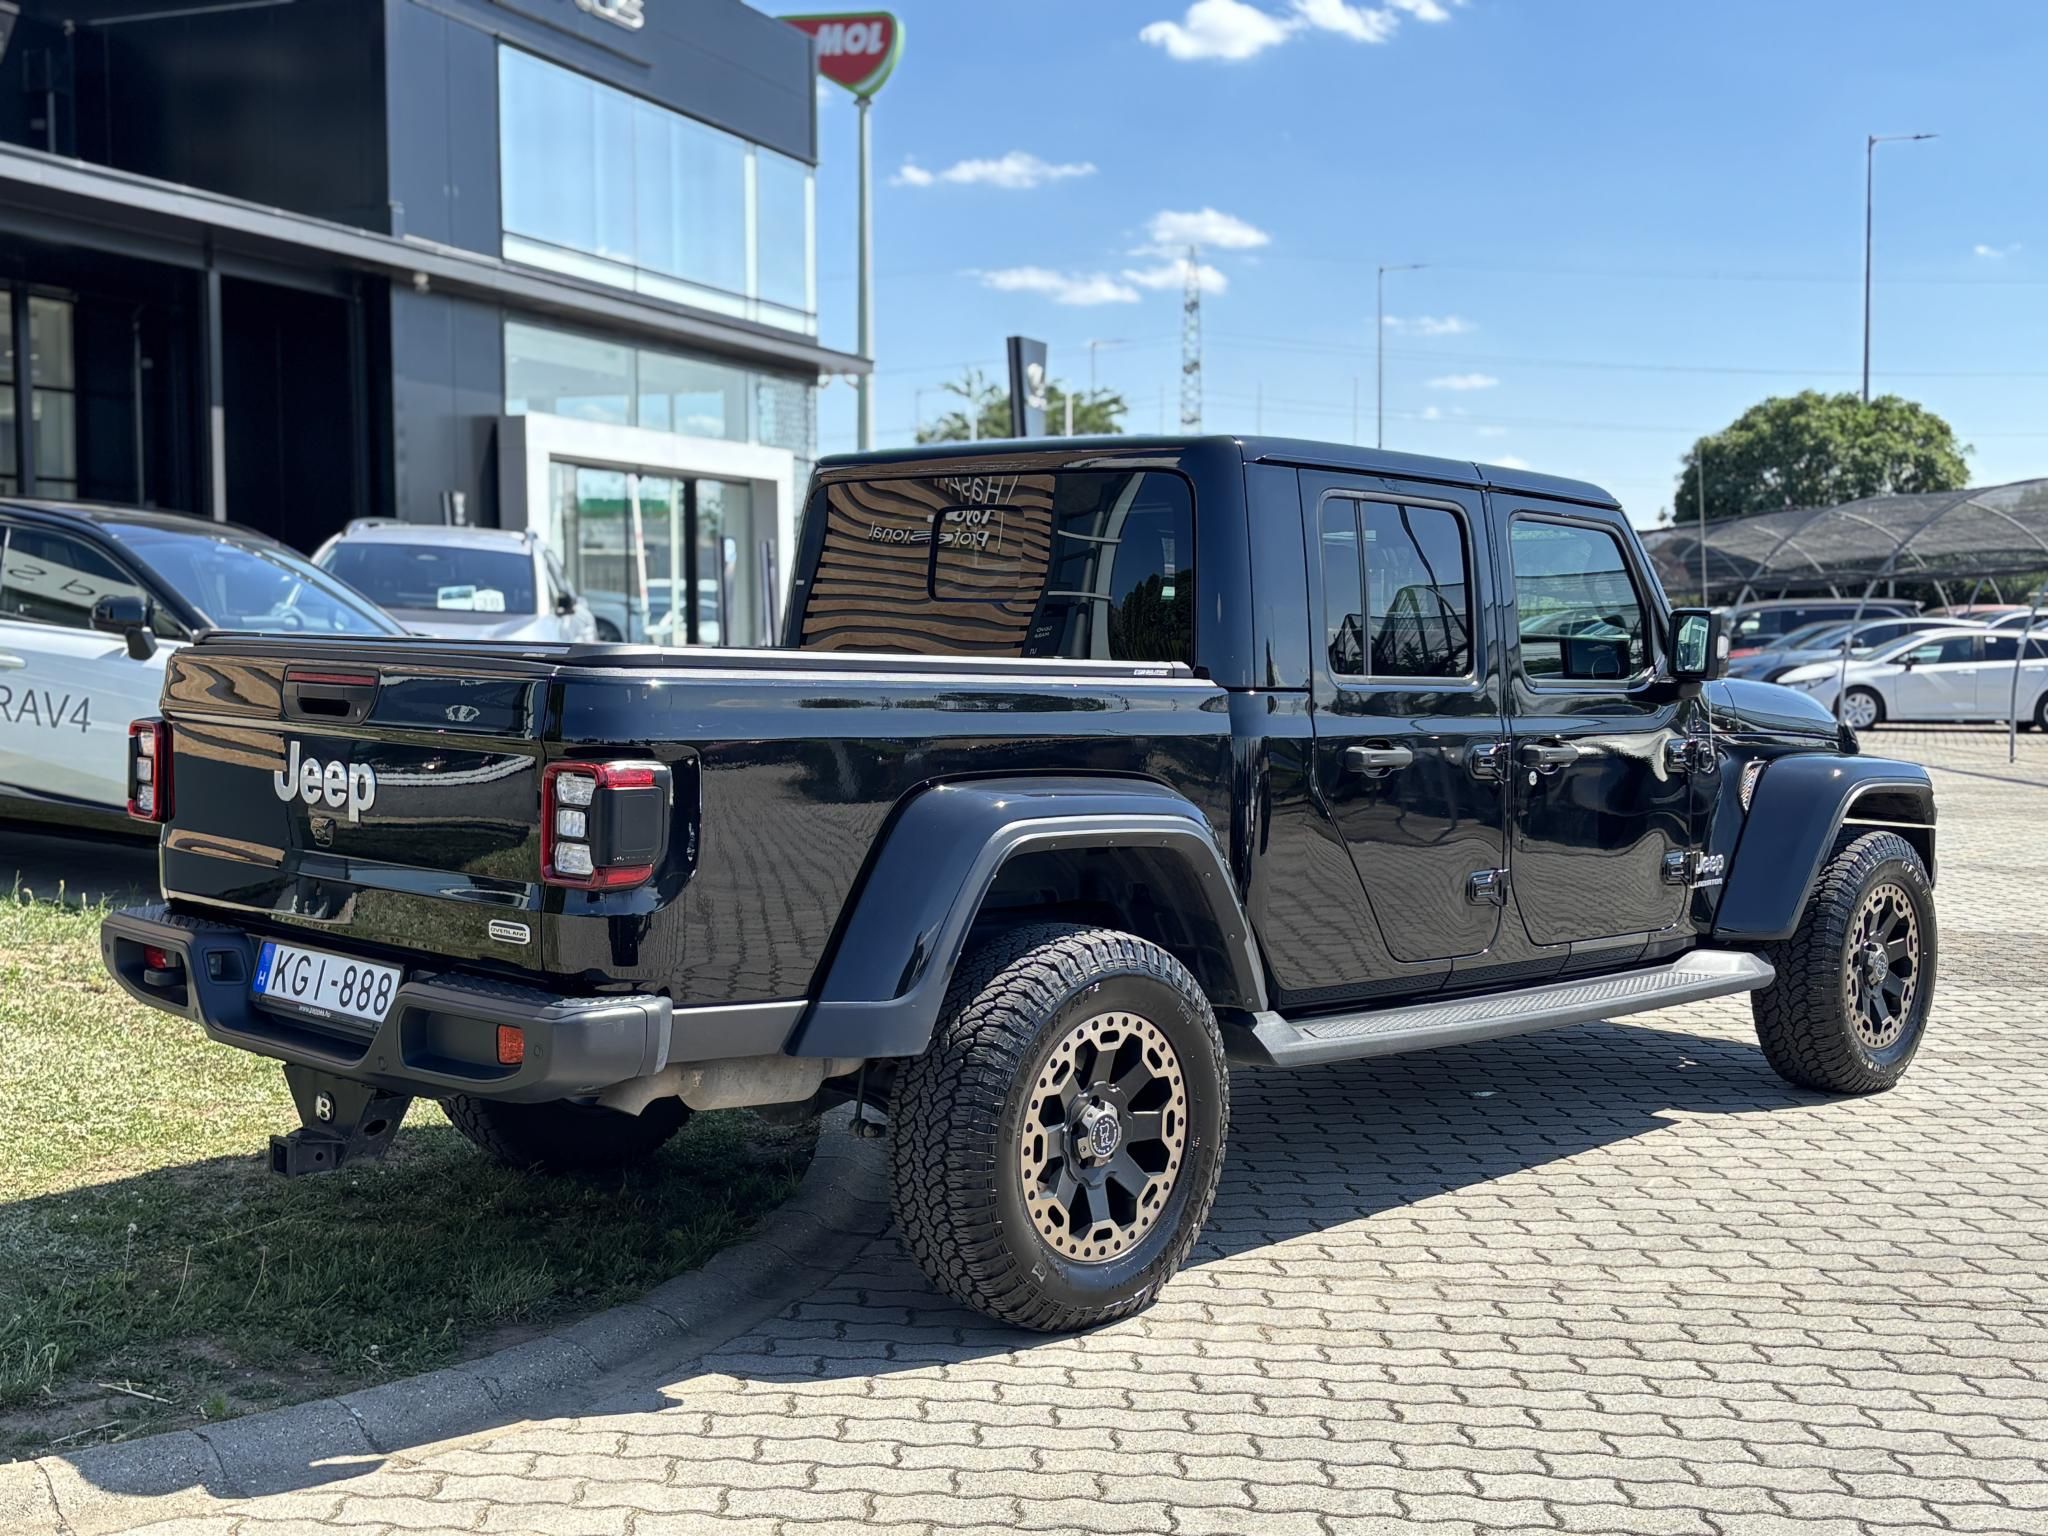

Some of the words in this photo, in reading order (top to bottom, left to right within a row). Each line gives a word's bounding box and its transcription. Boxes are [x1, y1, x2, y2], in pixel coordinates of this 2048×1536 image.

[816, 22, 884, 57] MOL
[0, 685, 92, 734] RAV4
[274, 740, 376, 823] Jeep
[1695, 853, 1725, 876] Jeep
[490, 926, 527, 938] OVERLAND
[257, 970, 267, 987] H
[271, 950, 393, 1016] KGI-888
